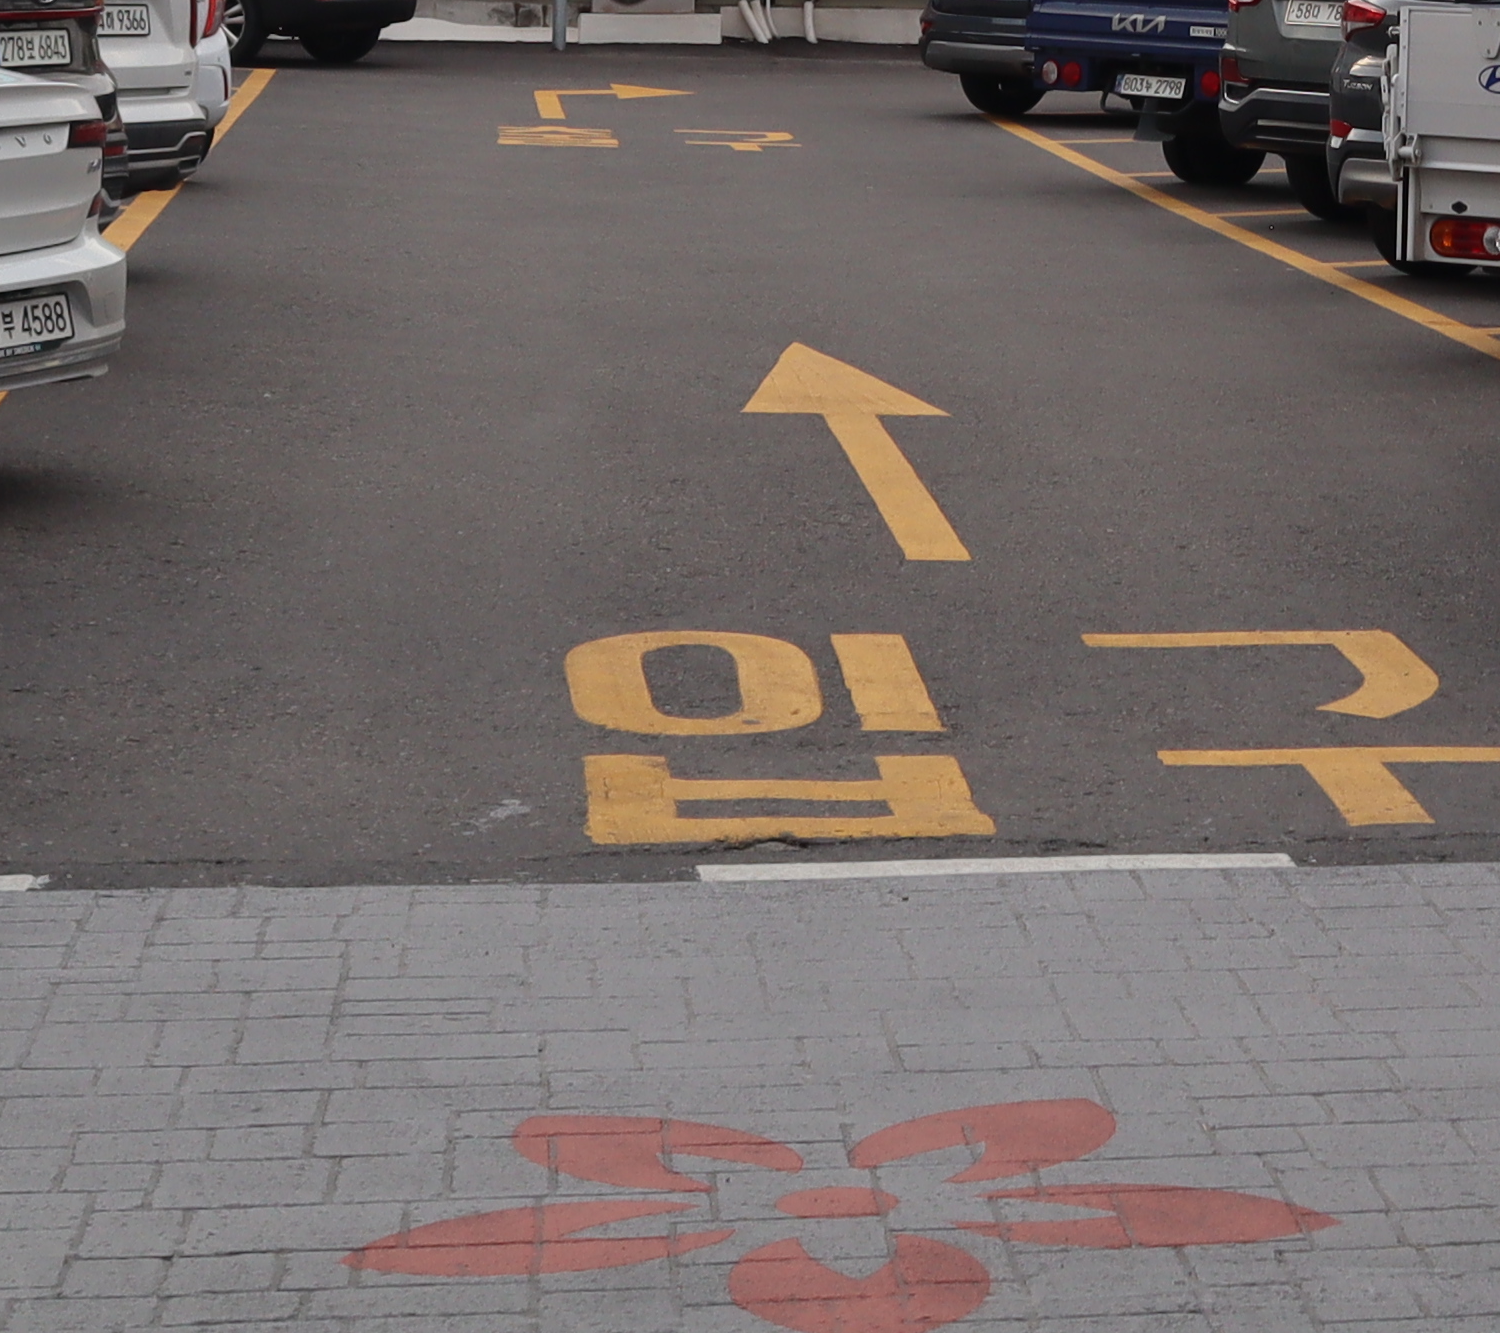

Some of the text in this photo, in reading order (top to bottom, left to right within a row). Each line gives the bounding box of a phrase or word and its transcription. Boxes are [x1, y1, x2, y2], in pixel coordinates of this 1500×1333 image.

[117, 9, 146, 31] 9366
[1111, 13, 1166, 34] KIA
[0, 35, 68, 62] 278보 6843
[1154, 79, 1184, 96] 2798
[21, 301, 68, 338] 4588
